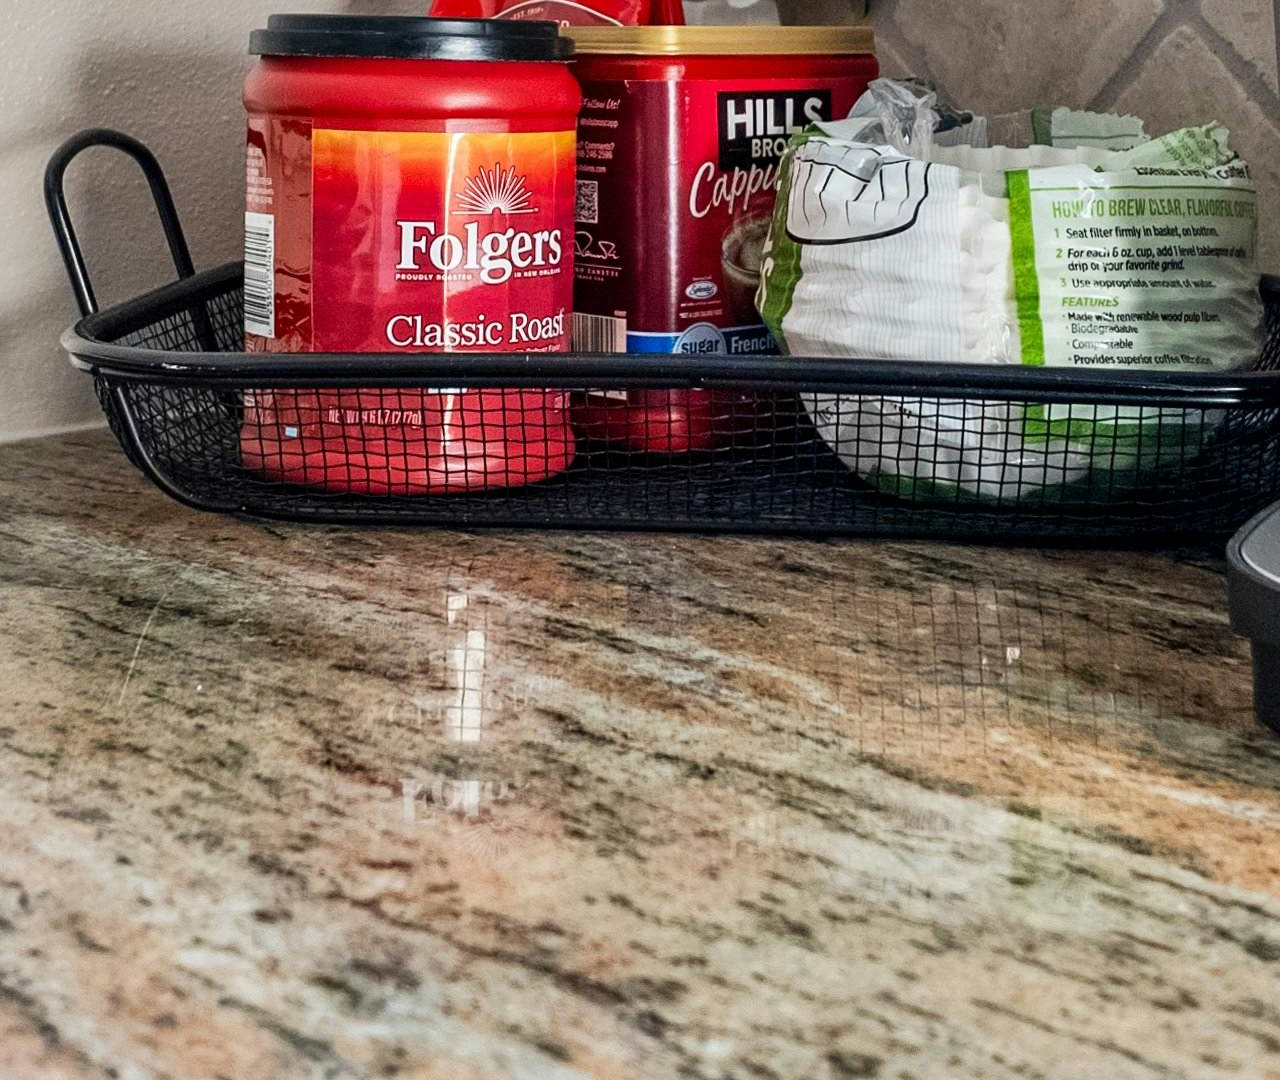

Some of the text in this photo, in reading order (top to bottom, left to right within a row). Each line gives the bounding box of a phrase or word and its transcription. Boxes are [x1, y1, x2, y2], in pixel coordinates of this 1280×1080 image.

[727, 97, 823, 140] HILLS
[751, 137, 789, 158] BRO
[1052, 201, 1084, 218] HOW
[1108, 198, 1146, 217] BREW
[1149, 198, 1186, 218] CLEAR,
[1066, 227, 1088, 238] Seat
[1089, 226, 1113, 238] filter
[1115, 226, 1141, 239] firmly
[1143, 225, 1152, 237] in
[396, 221, 562, 284] Folgers
[1056, 248, 1062, 258] 2
[1068, 248, 1084, 259] For
[1086, 247, 1110, 258] each
[1112, 246, 1118, 258] 6
[1136, 248, 1154, 260] cup,
[1156, 245, 1173, 257] add
[1068, 260, 1088, 272] drip
[1126, 260, 1160, 270] favorite
[1072, 278, 1091, 288] Use
[1062, 296, 1120, 307] FEATURES
[1068, 312, 1092, 322] Made
[386, 308, 565, 346] Classic Roast
[682, 335, 775, 354] sugar French
[1074, 354, 1115, 365] Provides
[1116, 354, 1152, 366] superior
